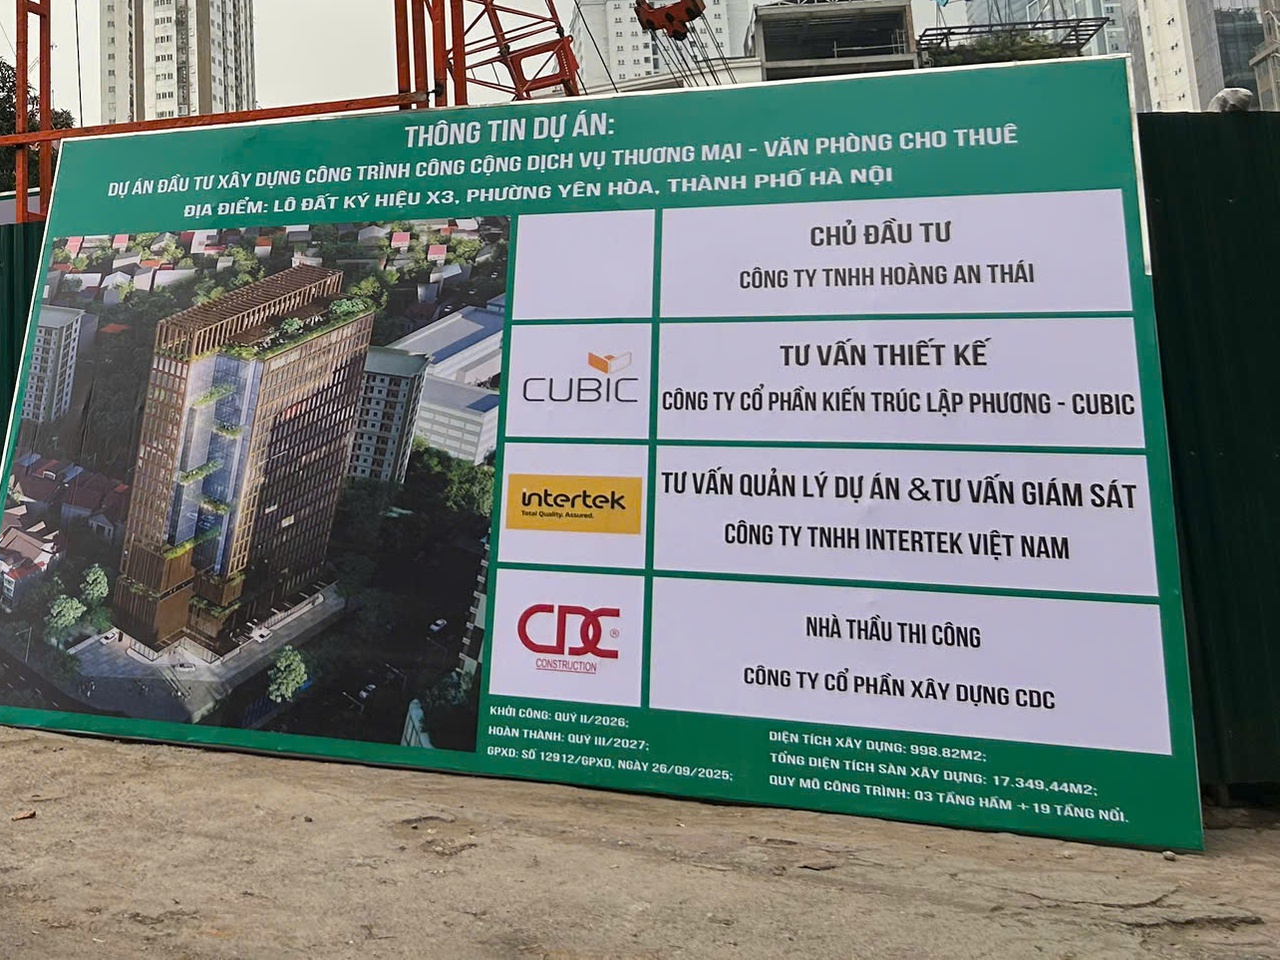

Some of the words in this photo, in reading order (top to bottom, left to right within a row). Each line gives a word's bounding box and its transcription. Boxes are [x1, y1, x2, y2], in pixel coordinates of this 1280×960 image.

[405, 120, 481, 147] THÔNG
[488, 118, 523, 142] TIN
[533, 114, 567, 142] DỰ
[572, 110, 614, 137] ÁN:
[108, 181, 130, 198] DỰ
[132, 178, 154, 195] ÁN
[158, 174, 189, 193] ĐẦU
[194, 175, 214, 190] TƯ
[217, 171, 251, 189] XÂY
[255, 170, 301, 188] DỰNG
[306, 166, 351, 183] CÔNG
[357, 162, 410, 180] TRÌNH
[416, 159, 465, 177] CÔNG
[471, 155, 521, 176] CỘNG
[527, 153, 573, 173] DỊCH
[580, 151, 606, 170] VỤ
[612, 146, 695, 165] THƯƠNG
[702, 143, 742, 163] MẠI
[764, 137, 808, 157] VĂN
[816, 133, 892, 154] PHÒNG
[900, 131, 947, 149] CHO
[953, 123, 1018, 146] THUÊ
[184, 204, 212, 218] ĐỊA
[217, 197, 268, 215] ĐIỂM:
[274, 197, 296, 212] LÔ
[301, 193, 339, 210] ĐẤT
[344, 193, 370, 208] KÝ
[375, 190, 420, 208] HIỆU
[426, 191, 459, 204] X3,
[467, 185, 551, 202] PHƯỜNG
[558, 181, 601, 197] YÊN
[608, 179, 659, 195] HÒA,
[667, 175, 746, 192] THÀNH
[755, 168, 805, 188] PHỐ
[810, 168, 843, 186] HÀ
[851, 165, 892, 185] NỘI
[811, 220, 856, 246] CHỦ
[864, 218, 912, 244] ĐẦU
[919, 221, 951, 242] TƯ
[740, 267, 788, 288] CÔNG
[794, 269, 816, 287] TY
[822, 268, 874, 286] TNHH
[881, 263, 947, 285] HOÀNG
[954, 265, 981, 284] AN
[987, 260, 1034, 283] THÁI
[780, 344, 810, 366] TƯ
[817, 338, 866, 366] VẤN
[873, 338, 945, 365] THIẾT
[954, 338, 991, 365] KẾ
[523, 378, 638, 402] CUBIC
[663, 388, 708, 410] CÔNG
[713, 392, 735, 410] TY
[741, 384, 764, 411] CỔ
[769, 386, 816, 411] PHẦN
[823, 386, 865, 411] KIẾN
[871, 388, 920, 412] TRÚC
[927, 389, 963, 417] LẬP
[969, 392, 1051, 414] PHƯƠNG
[1072, 394, 1134, 415] CUBIC
[522, 488, 626, 510] intertek
[661, 471, 687, 494] TƯ
[692, 467, 733, 495] VẤN
[740, 468, 795, 497] QUẢN
[803, 471, 828, 498] LÝ
[835, 476, 863, 503] DỰ
[870, 473, 899, 500] ÁN
[967, 474, 1014, 504] VẤN
[1022, 478, 1083, 506] GIÁM
[1090, 479, 1136, 508] SÁT
[725, 520, 773, 545] CÔNG
[778, 525, 802, 546] TY
[807, 527, 859, 549] TNHH
[866, 529, 963, 554] INTERTEK
[968, 530, 1014, 560] VIỆT
[1021, 536, 1069, 559] NAM
[517, 604, 620, 659] CDC
[807, 614, 841, 638] NHÀ
[846, 615, 892, 642] THẦU
[897, 622, 926, 644] THI
[932, 622, 980, 648] CÔNG
[536, 658, 597, 672] CONSTRUCTION
[744, 665, 790, 687] CÔNG
[796, 671, 819, 689] TY
[825, 668, 849, 691] CỔ
[854, 673, 904, 697] PHẦN
[911, 678, 950, 700] XÂY
[956, 685, 1009, 706] DỰNG
[1016, 689, 1055, 709] CDC
[490, 705, 516, 717] KHỞI
[519, 708, 552, 719] CÔNG:
[580, 715, 628, 727] II/2026;
[489, 726, 519, 737] HOÀN
[523, 730, 565, 741] THÀNH:
[595, 737, 648, 750] III/2027;
[770, 731, 799, 743] DIỆN
[802, 734, 831, 746] TÍCH
[836, 737, 862, 749] XÂY
[866, 740, 906, 753] DỰNG:
[487, 746, 519, 757] GPXD:
[522, 748, 537, 759] SỐ
[618, 760, 648, 771] NGÀY
[652, 763, 732, 780] 26/09/2025;
[770, 751, 805, 765] TỔNG
[809, 757, 839, 769] DIỆN
[843, 760, 874, 772] TÍCH
[879, 763, 906, 775] SÀN
[911, 767, 939, 779] XÂY
[944, 771, 986, 784] DỰNG:
[770, 775, 795, 786] QUY
[808, 778, 820, 789] MÔ
[824, 780, 860, 793] CÔNG
[864, 785, 910, 799] TRÌNH:
[915, 791, 933, 801] 03
[937, 792, 974, 806] TẦNG
[979, 796, 1012, 810] HẦM
[1033, 803, 1050, 813] 19
[1054, 804, 1094, 818] TẦNG
[1099, 807, 1128, 822] NỔI.
